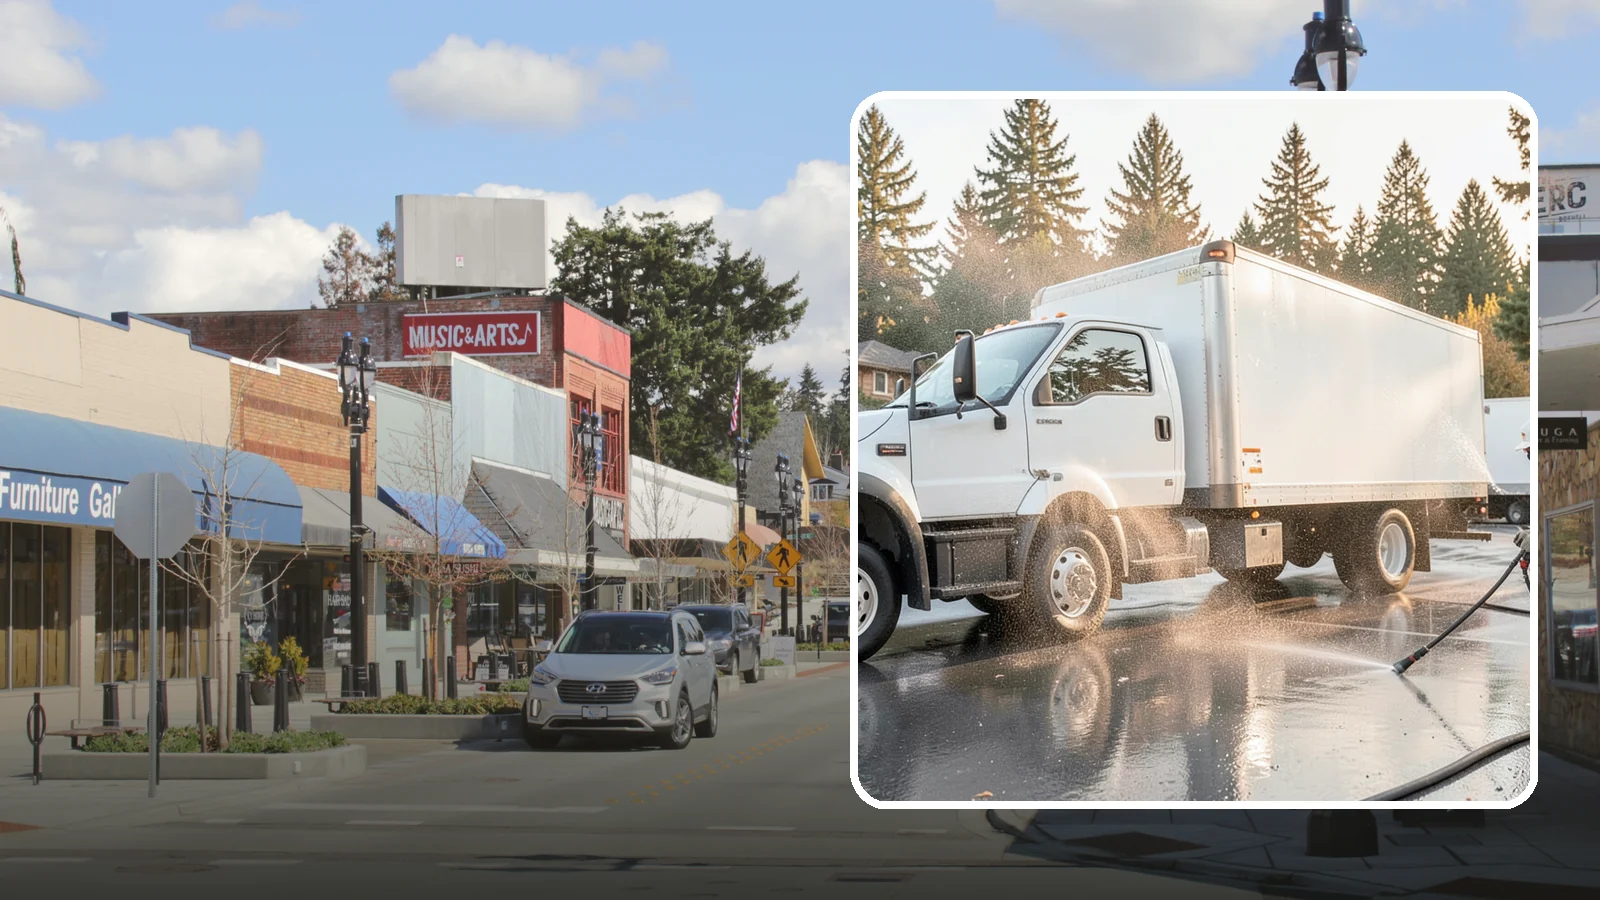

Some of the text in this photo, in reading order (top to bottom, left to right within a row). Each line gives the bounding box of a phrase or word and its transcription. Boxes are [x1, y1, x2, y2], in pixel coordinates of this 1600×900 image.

[0, 471, 122, 519] Furniture Gal
[453, 563, 480, 574] SUSHI
